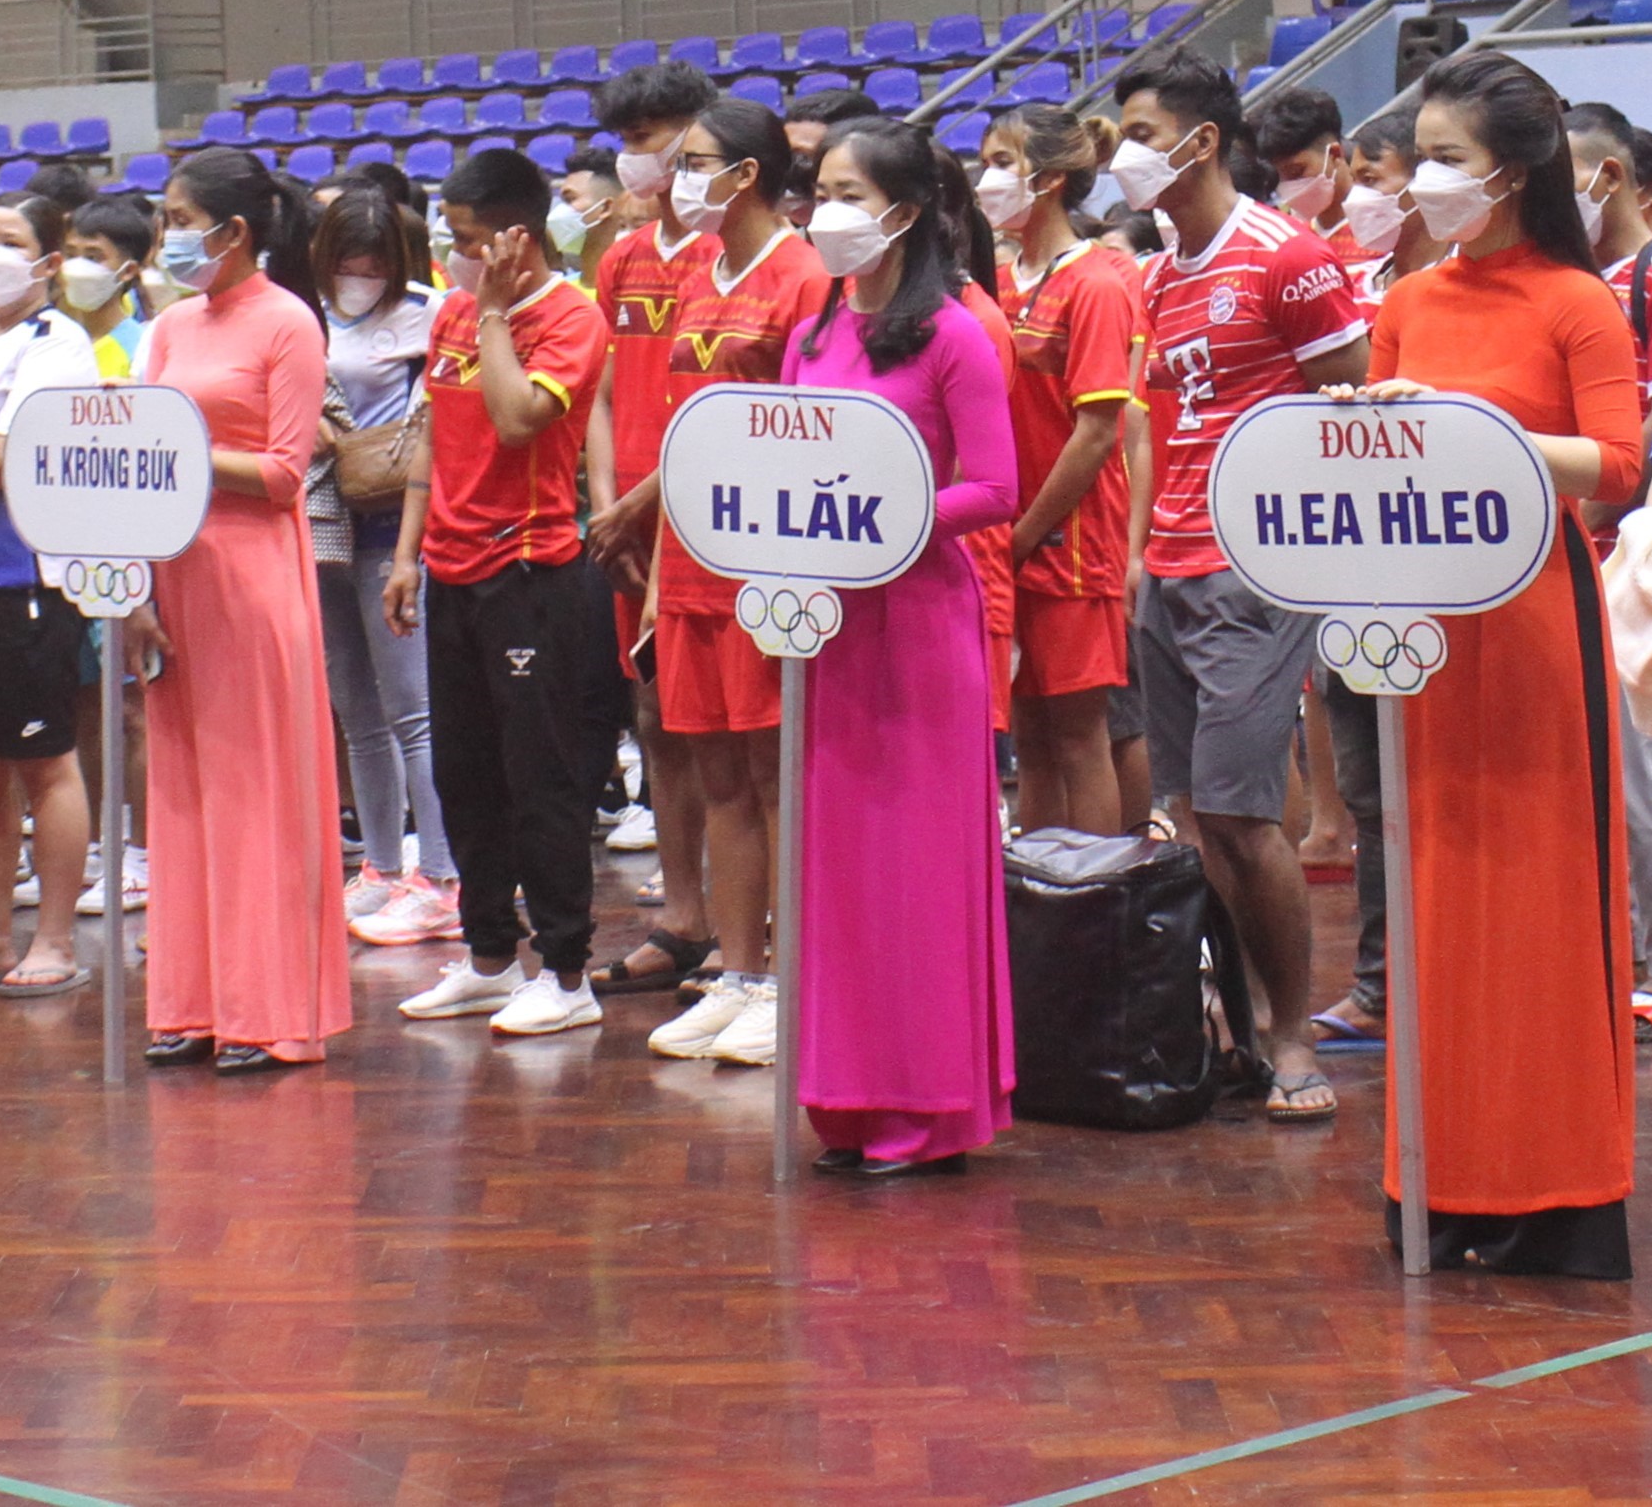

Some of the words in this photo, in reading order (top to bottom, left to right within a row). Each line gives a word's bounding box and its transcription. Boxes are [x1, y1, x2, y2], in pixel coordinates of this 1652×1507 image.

[1282, 262, 1342, 303] QATAR
[748, 394, 835, 441] ĐOÀN
[1319, 410, 1426, 459] ĐOÀN
[35, 445, 54, 486] H.
[61, 436, 129, 489] KRÔNG
[136, 439, 178, 491] BÚK
[712, 484, 759, 534] H.
[777, 473, 884, 544] LẮK
